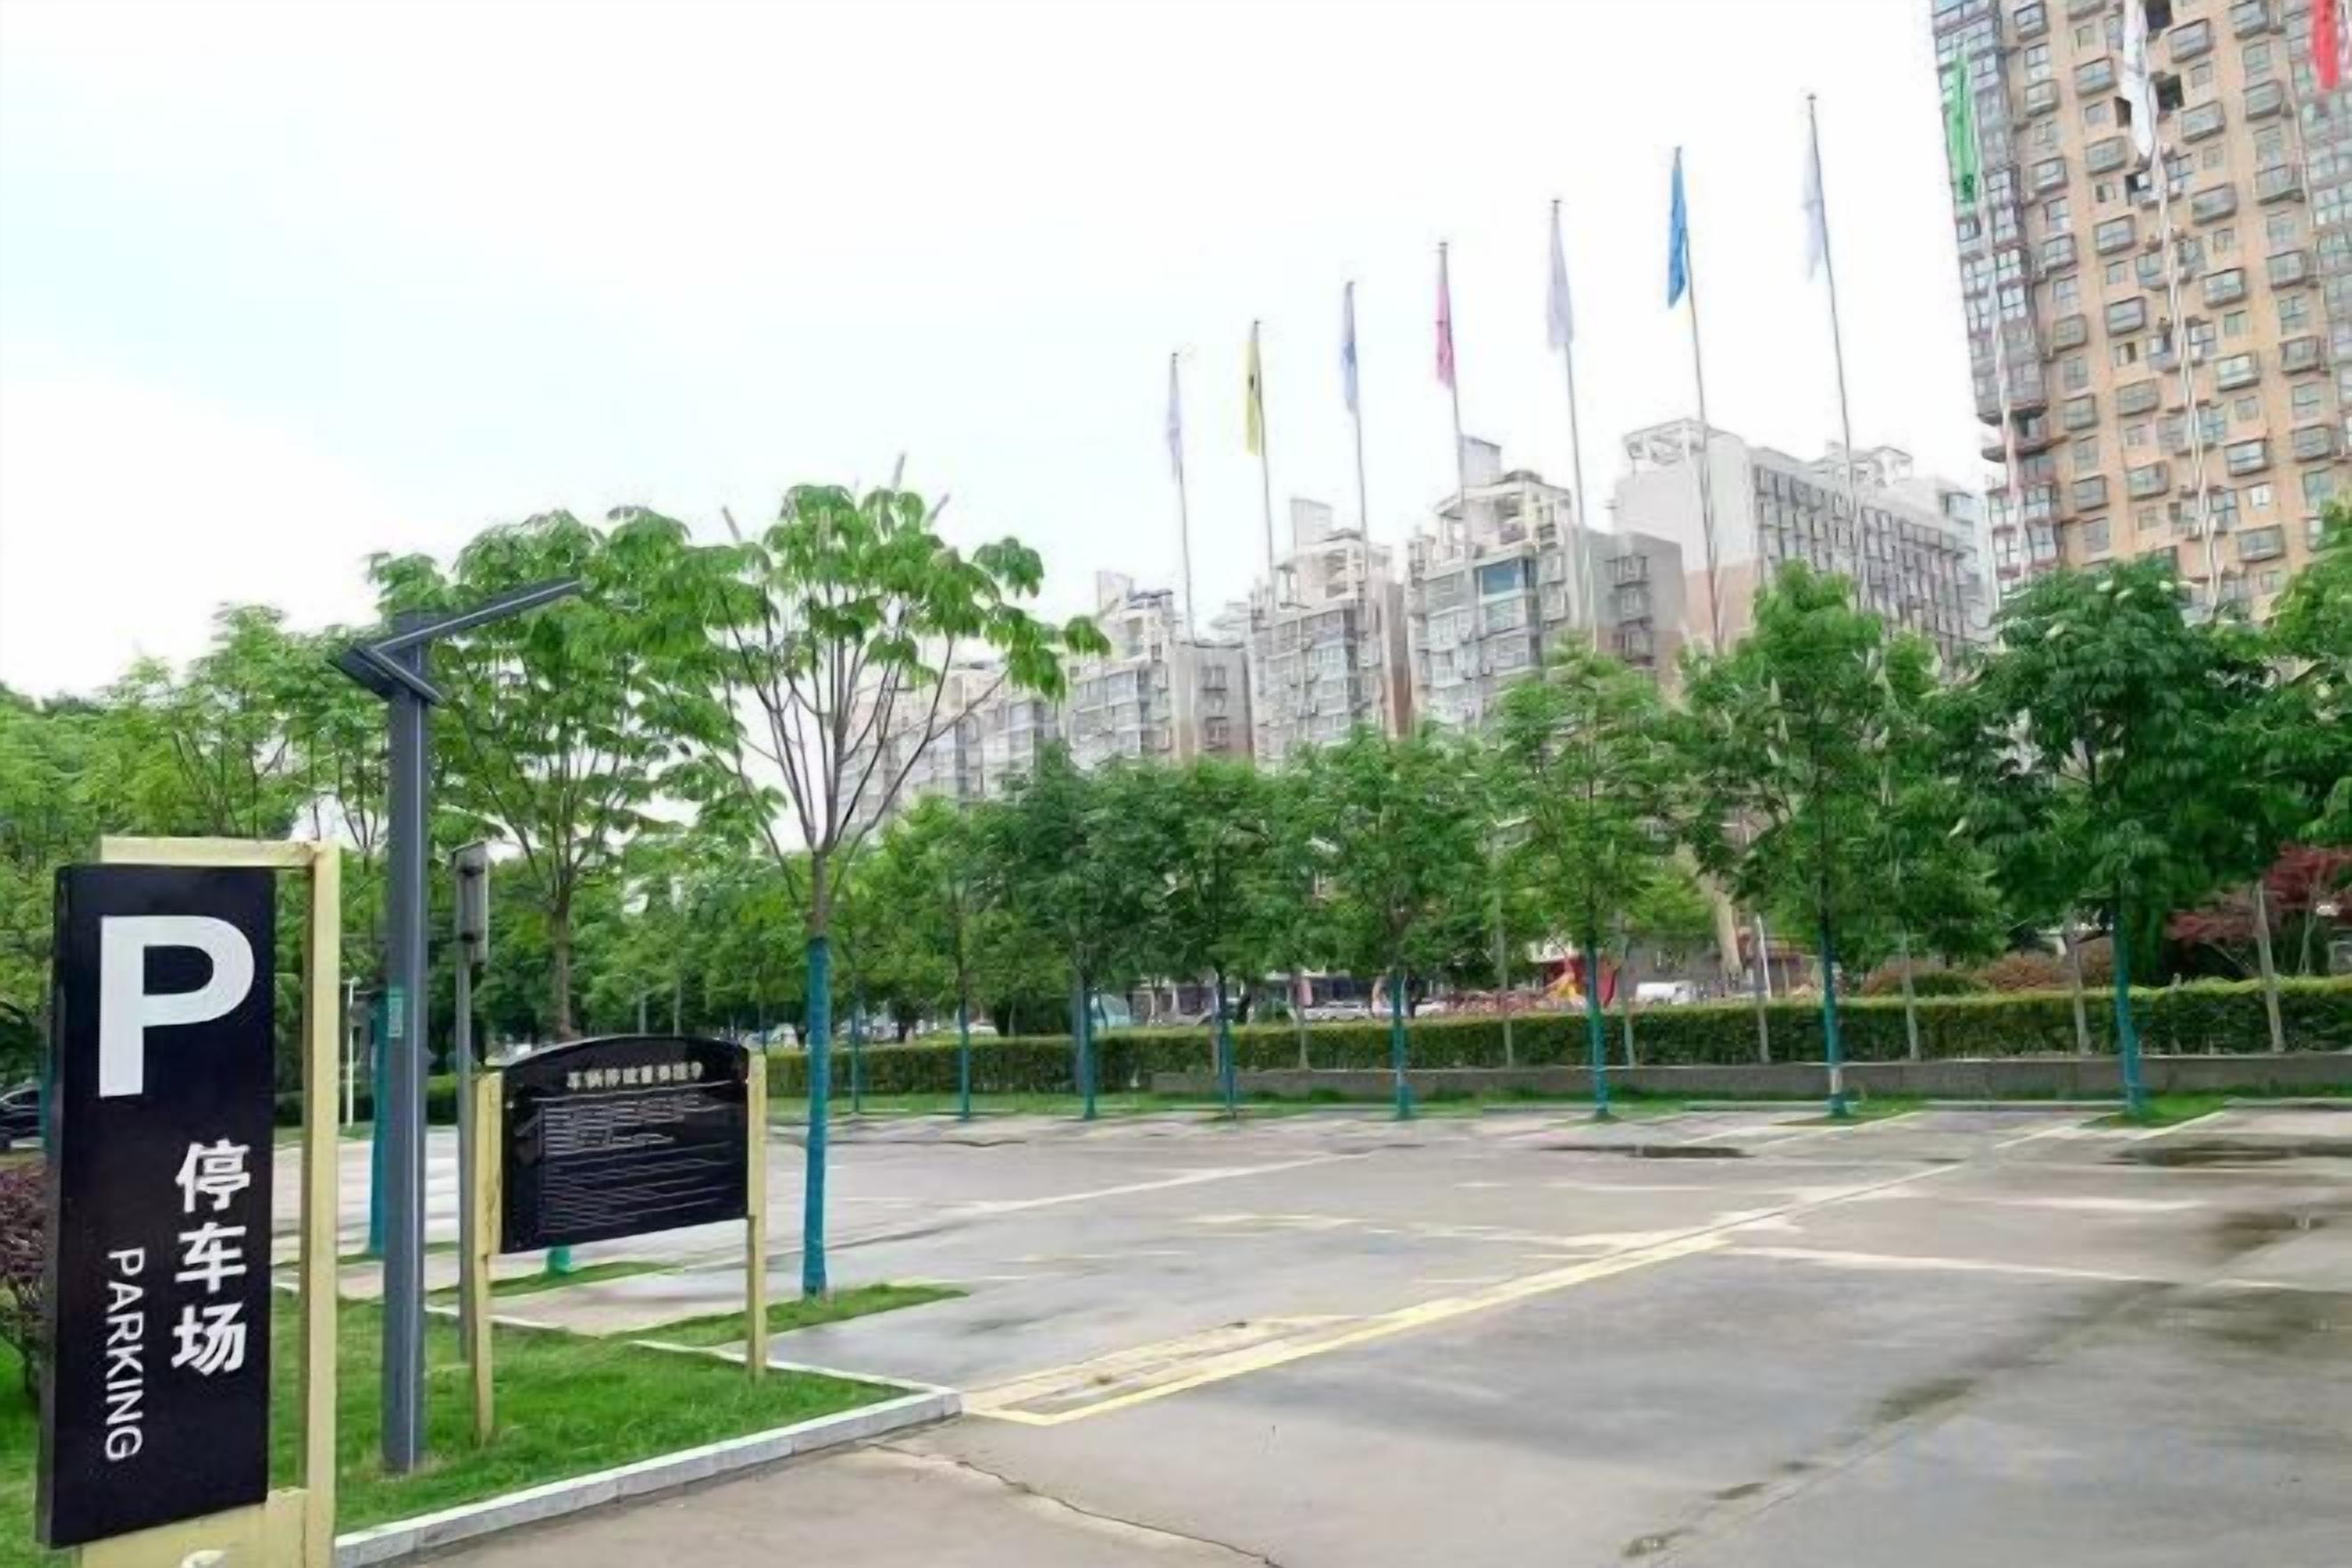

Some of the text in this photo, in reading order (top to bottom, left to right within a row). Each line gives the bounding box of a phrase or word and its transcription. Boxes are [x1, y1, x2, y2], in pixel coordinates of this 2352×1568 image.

[99, 915, 255, 1098] P
[105, 1247, 145, 1460] PARKING
[172, 1138, 251, 1376] 停车场
